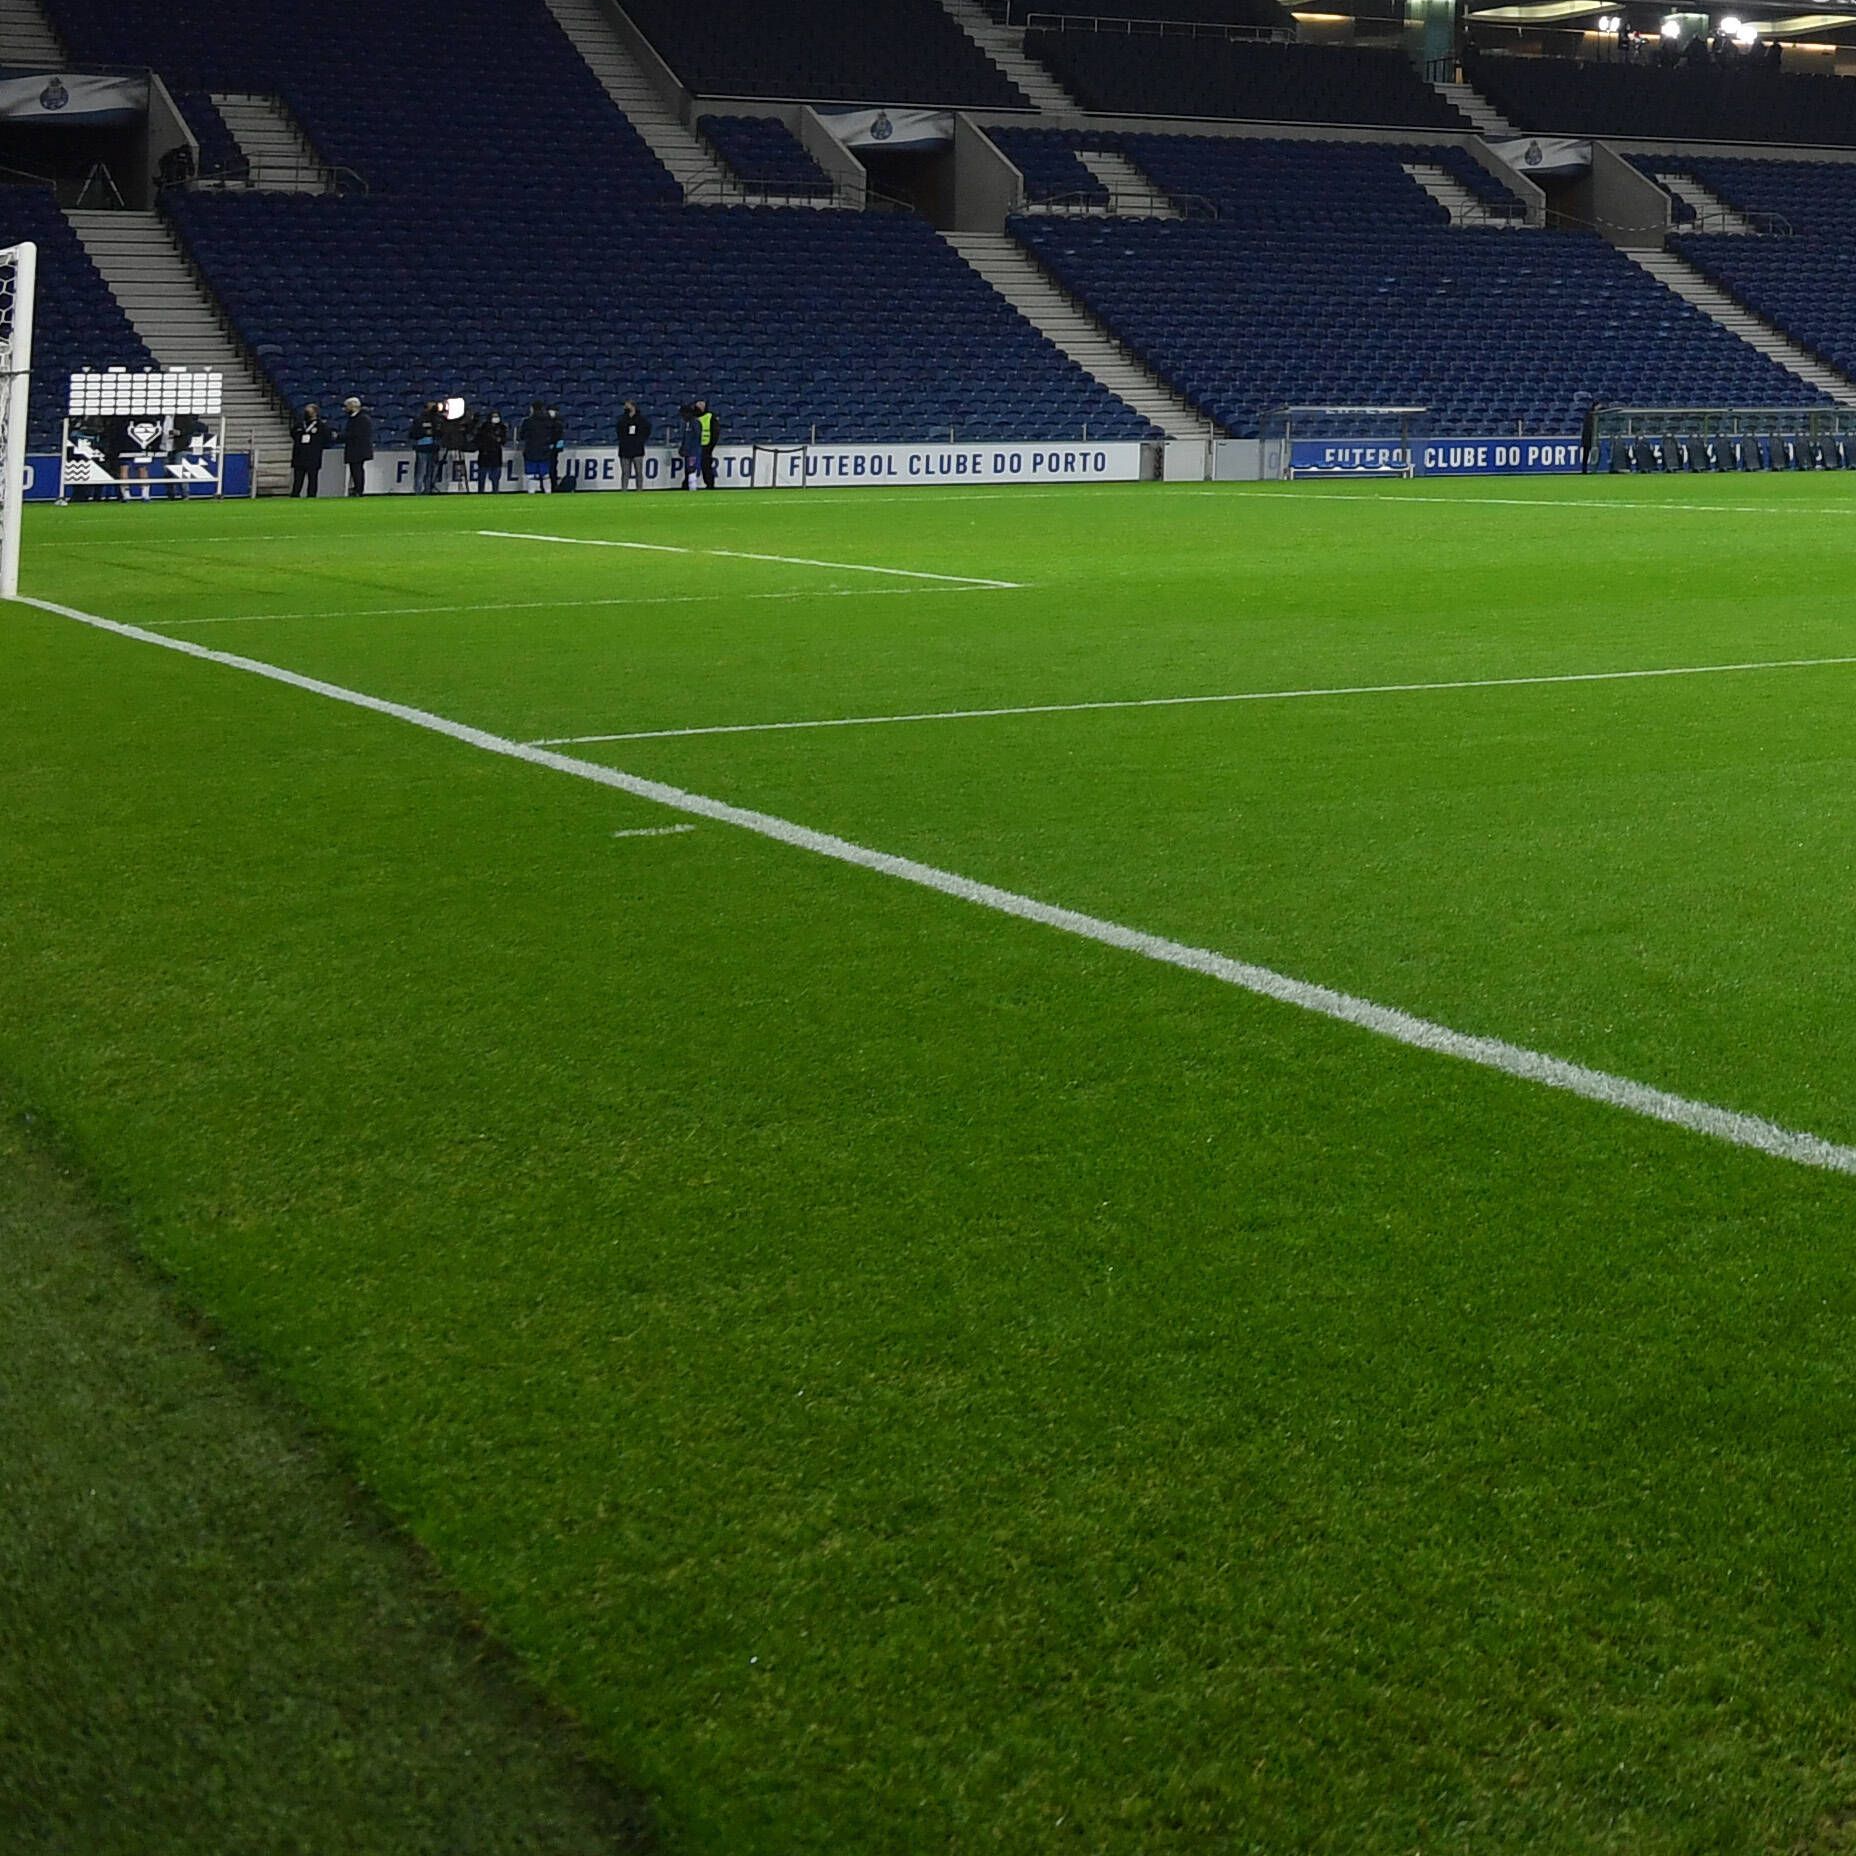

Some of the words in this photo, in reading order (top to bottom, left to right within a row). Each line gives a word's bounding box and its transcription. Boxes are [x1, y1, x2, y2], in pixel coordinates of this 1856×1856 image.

[670, 456, 753, 478] PRTO
[789, 454, 897, 477] FUTEBOL
[909, 452, 983, 476] CLUBE
[993, 452, 1022, 474] DO
[1032, 451, 1107, 473] PORTO
[1424, 447, 1488, 468] CLUBE
[1495, 446, 1520, 467] DO
